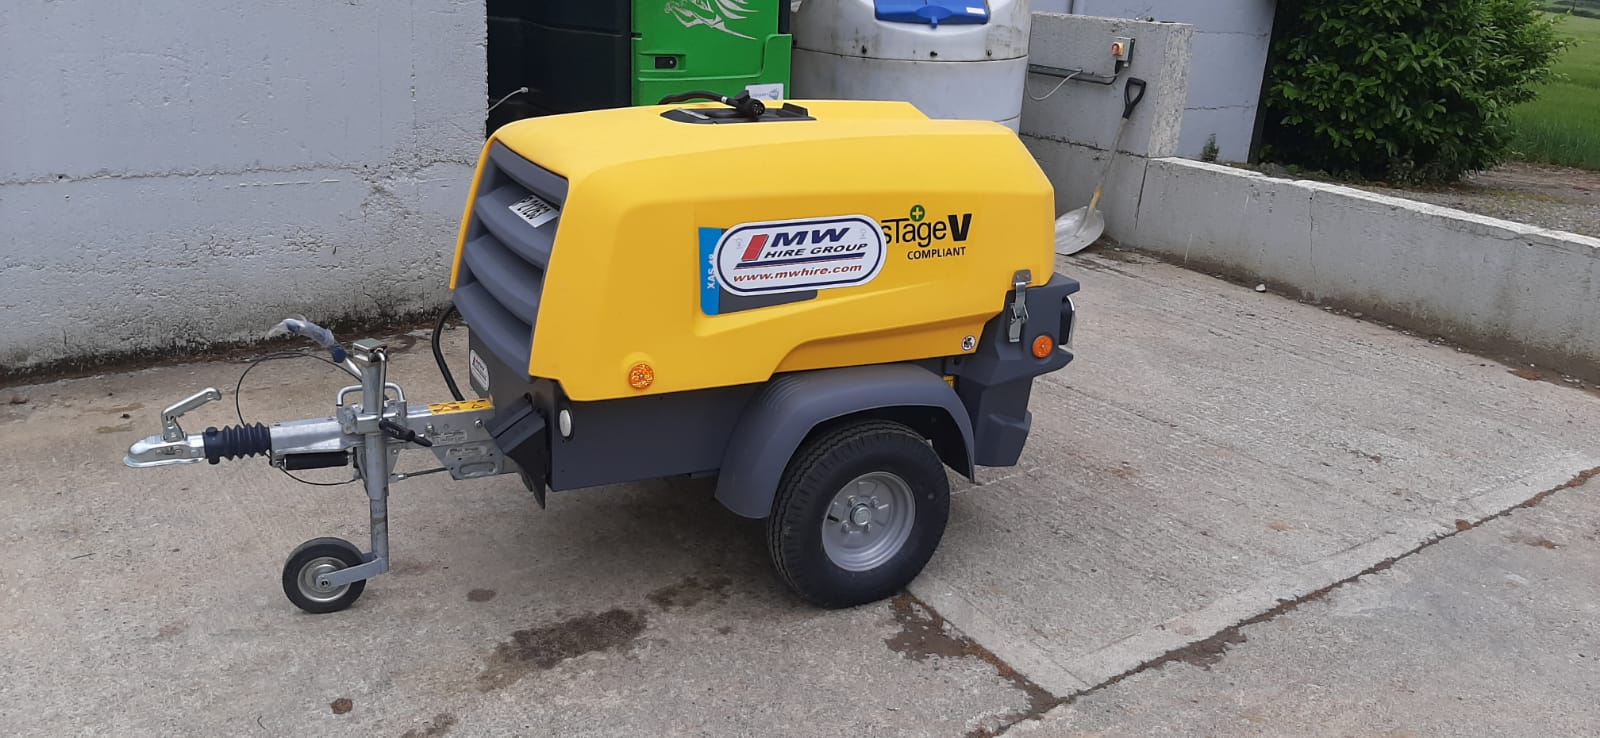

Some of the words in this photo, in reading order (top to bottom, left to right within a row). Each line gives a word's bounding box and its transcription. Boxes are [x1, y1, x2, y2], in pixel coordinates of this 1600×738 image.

[948, 213, 972, 242] V
[771, 228, 850, 247] MW
[764, 248, 806, 259] HIRE
[806, 243, 868, 255] GROUP
[907, 246, 966, 260] COMPLIANT
[733, 264, 862, 282] www.mwhire.com
